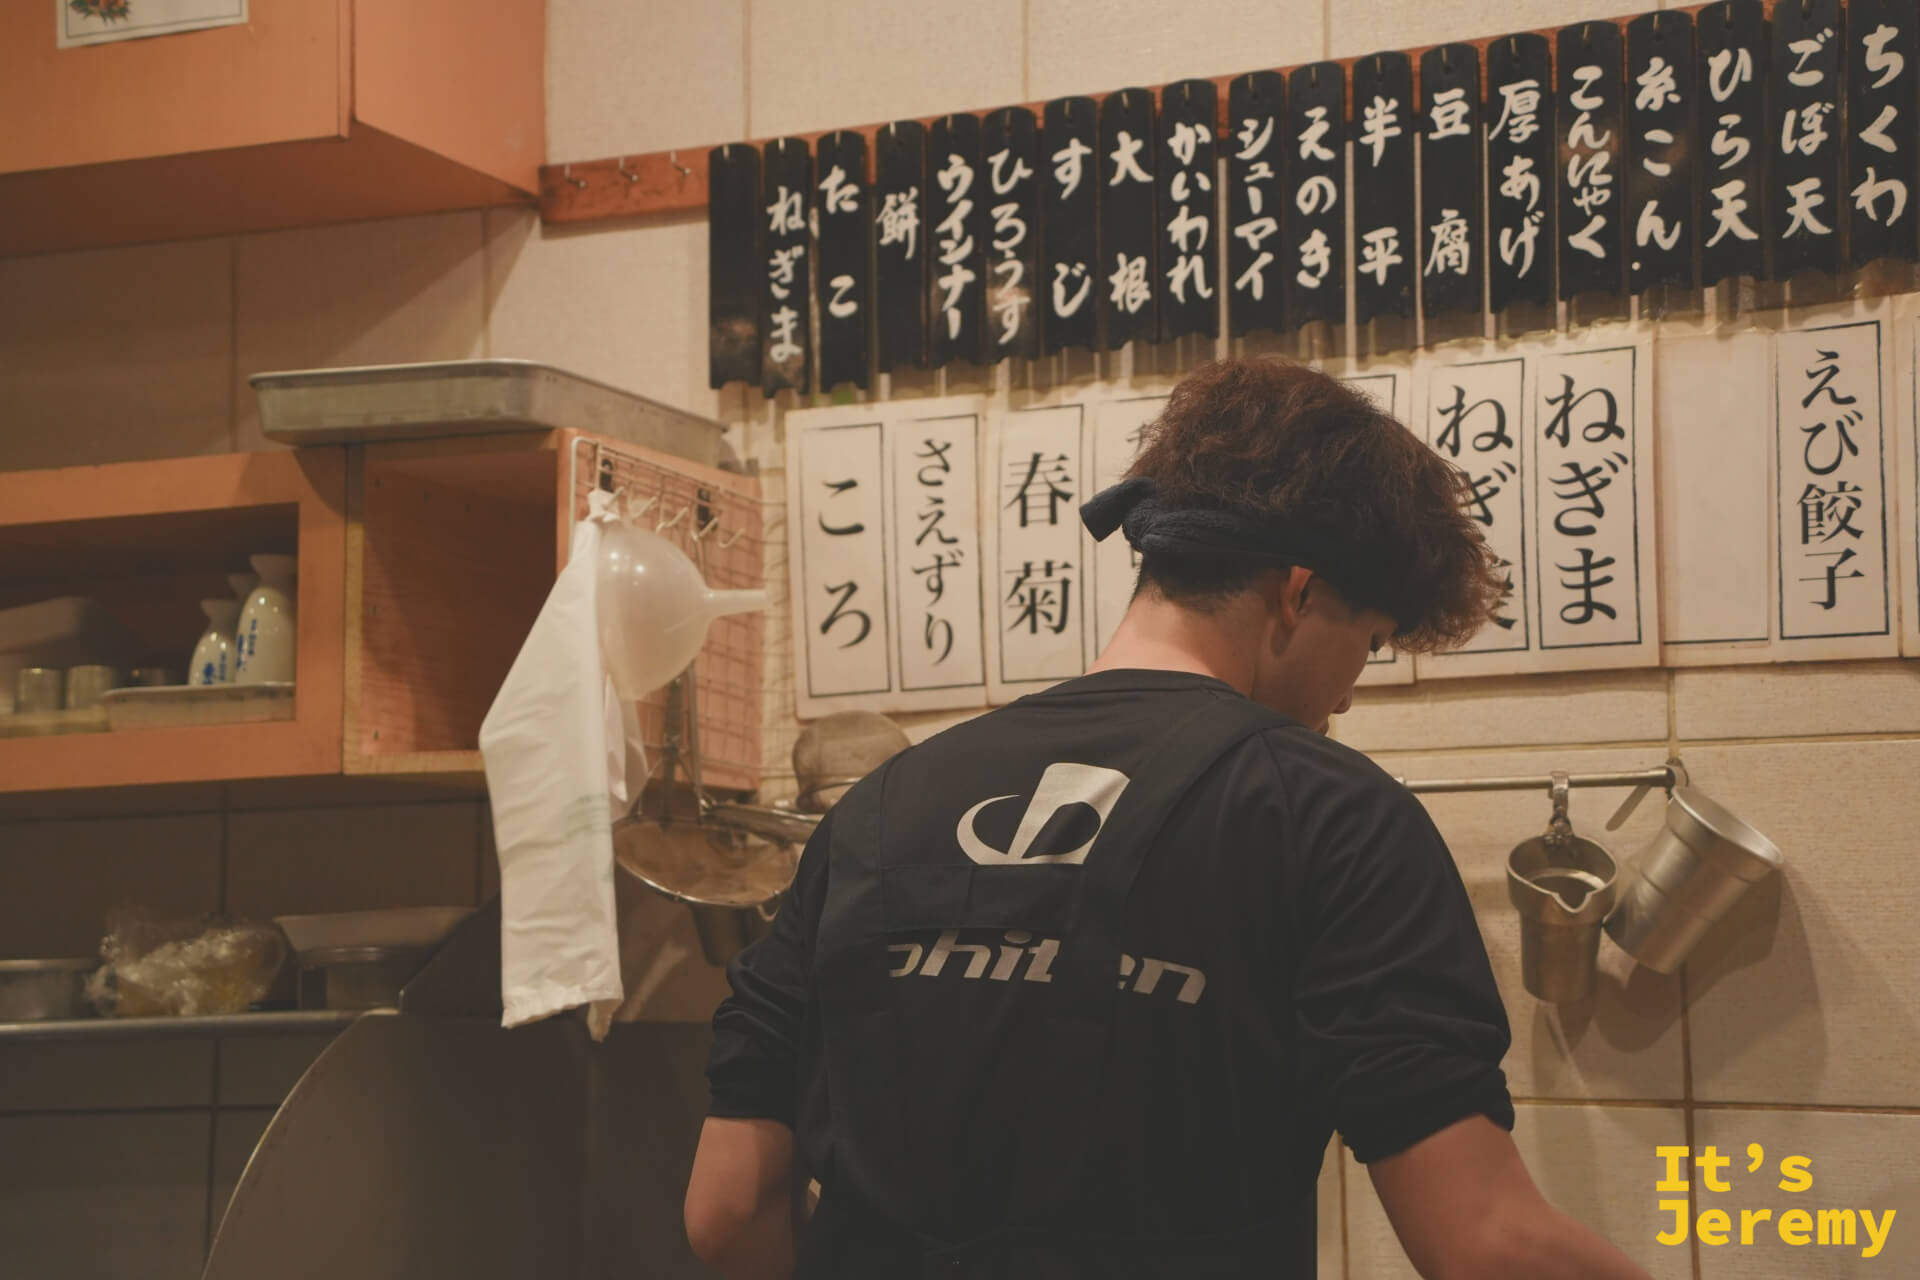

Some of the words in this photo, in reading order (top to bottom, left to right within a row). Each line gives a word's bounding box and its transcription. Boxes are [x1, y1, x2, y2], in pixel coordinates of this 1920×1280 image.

[1166, 122, 1213, 304] かいわれ
[1234, 116, 1278, 300] シューマイ
[1296, 106, 1337, 288] えのき
[1358, 95, 1403, 286] 半平
[1424, 88, 1471, 276] 豆腐
[1488, 79, 1545, 279] 厚あげ
[1567, 65, 1613, 259] こんにゃく
[1635, 56, 1681, 251] 糸こん
[1705, 48, 1759, 248] ひら天
[1781, 27, 1834, 239] ごぼ天
[1850, 24, 1908, 227] ちくわ
[766, 186, 806, 363] ねぎま
[819, 165, 860, 318] たこ
[935, 154, 976, 340] ウインナー
[987, 148, 1033, 344] ひろうす
[1052, 137, 1093, 318] すじ
[1108, 130, 1154, 313] 大根
[818, 478, 872, 650] ころ
[912, 438, 965, 667] さえずり
[1003, 451, 1075, 636] 春菊
[1543, 373, 1629, 627] ねぎま
[1796, 349, 1865, 611] えび餃子
